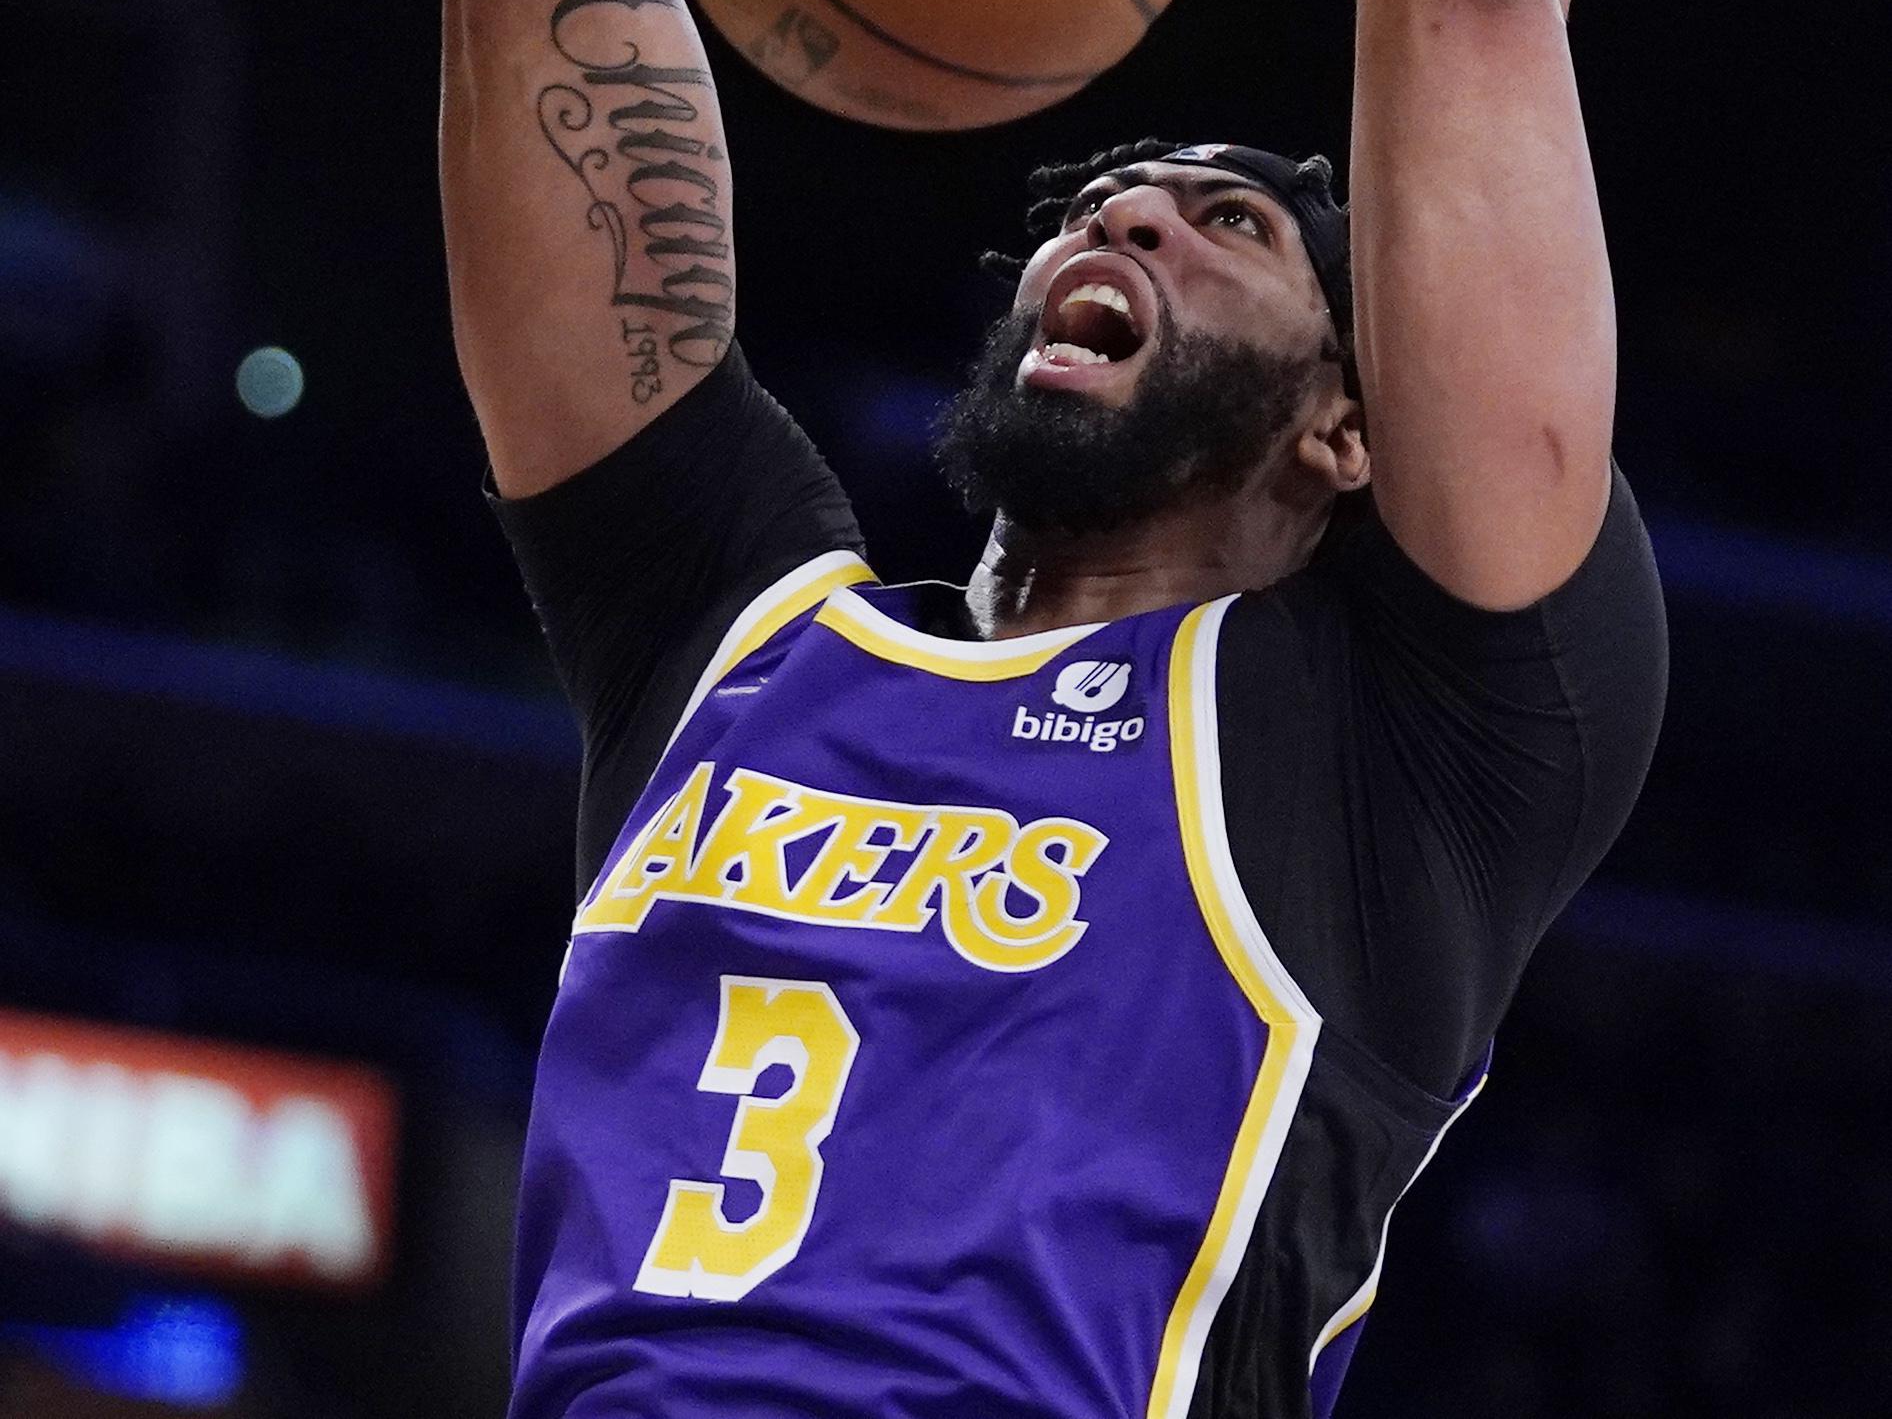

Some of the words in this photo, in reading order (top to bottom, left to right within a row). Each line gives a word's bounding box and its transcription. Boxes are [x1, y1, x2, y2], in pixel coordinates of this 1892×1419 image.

[621, 317, 663, 405] 1993
[1011, 705, 1145, 752] bibigo
[632, 974, 861, 1302] 3
